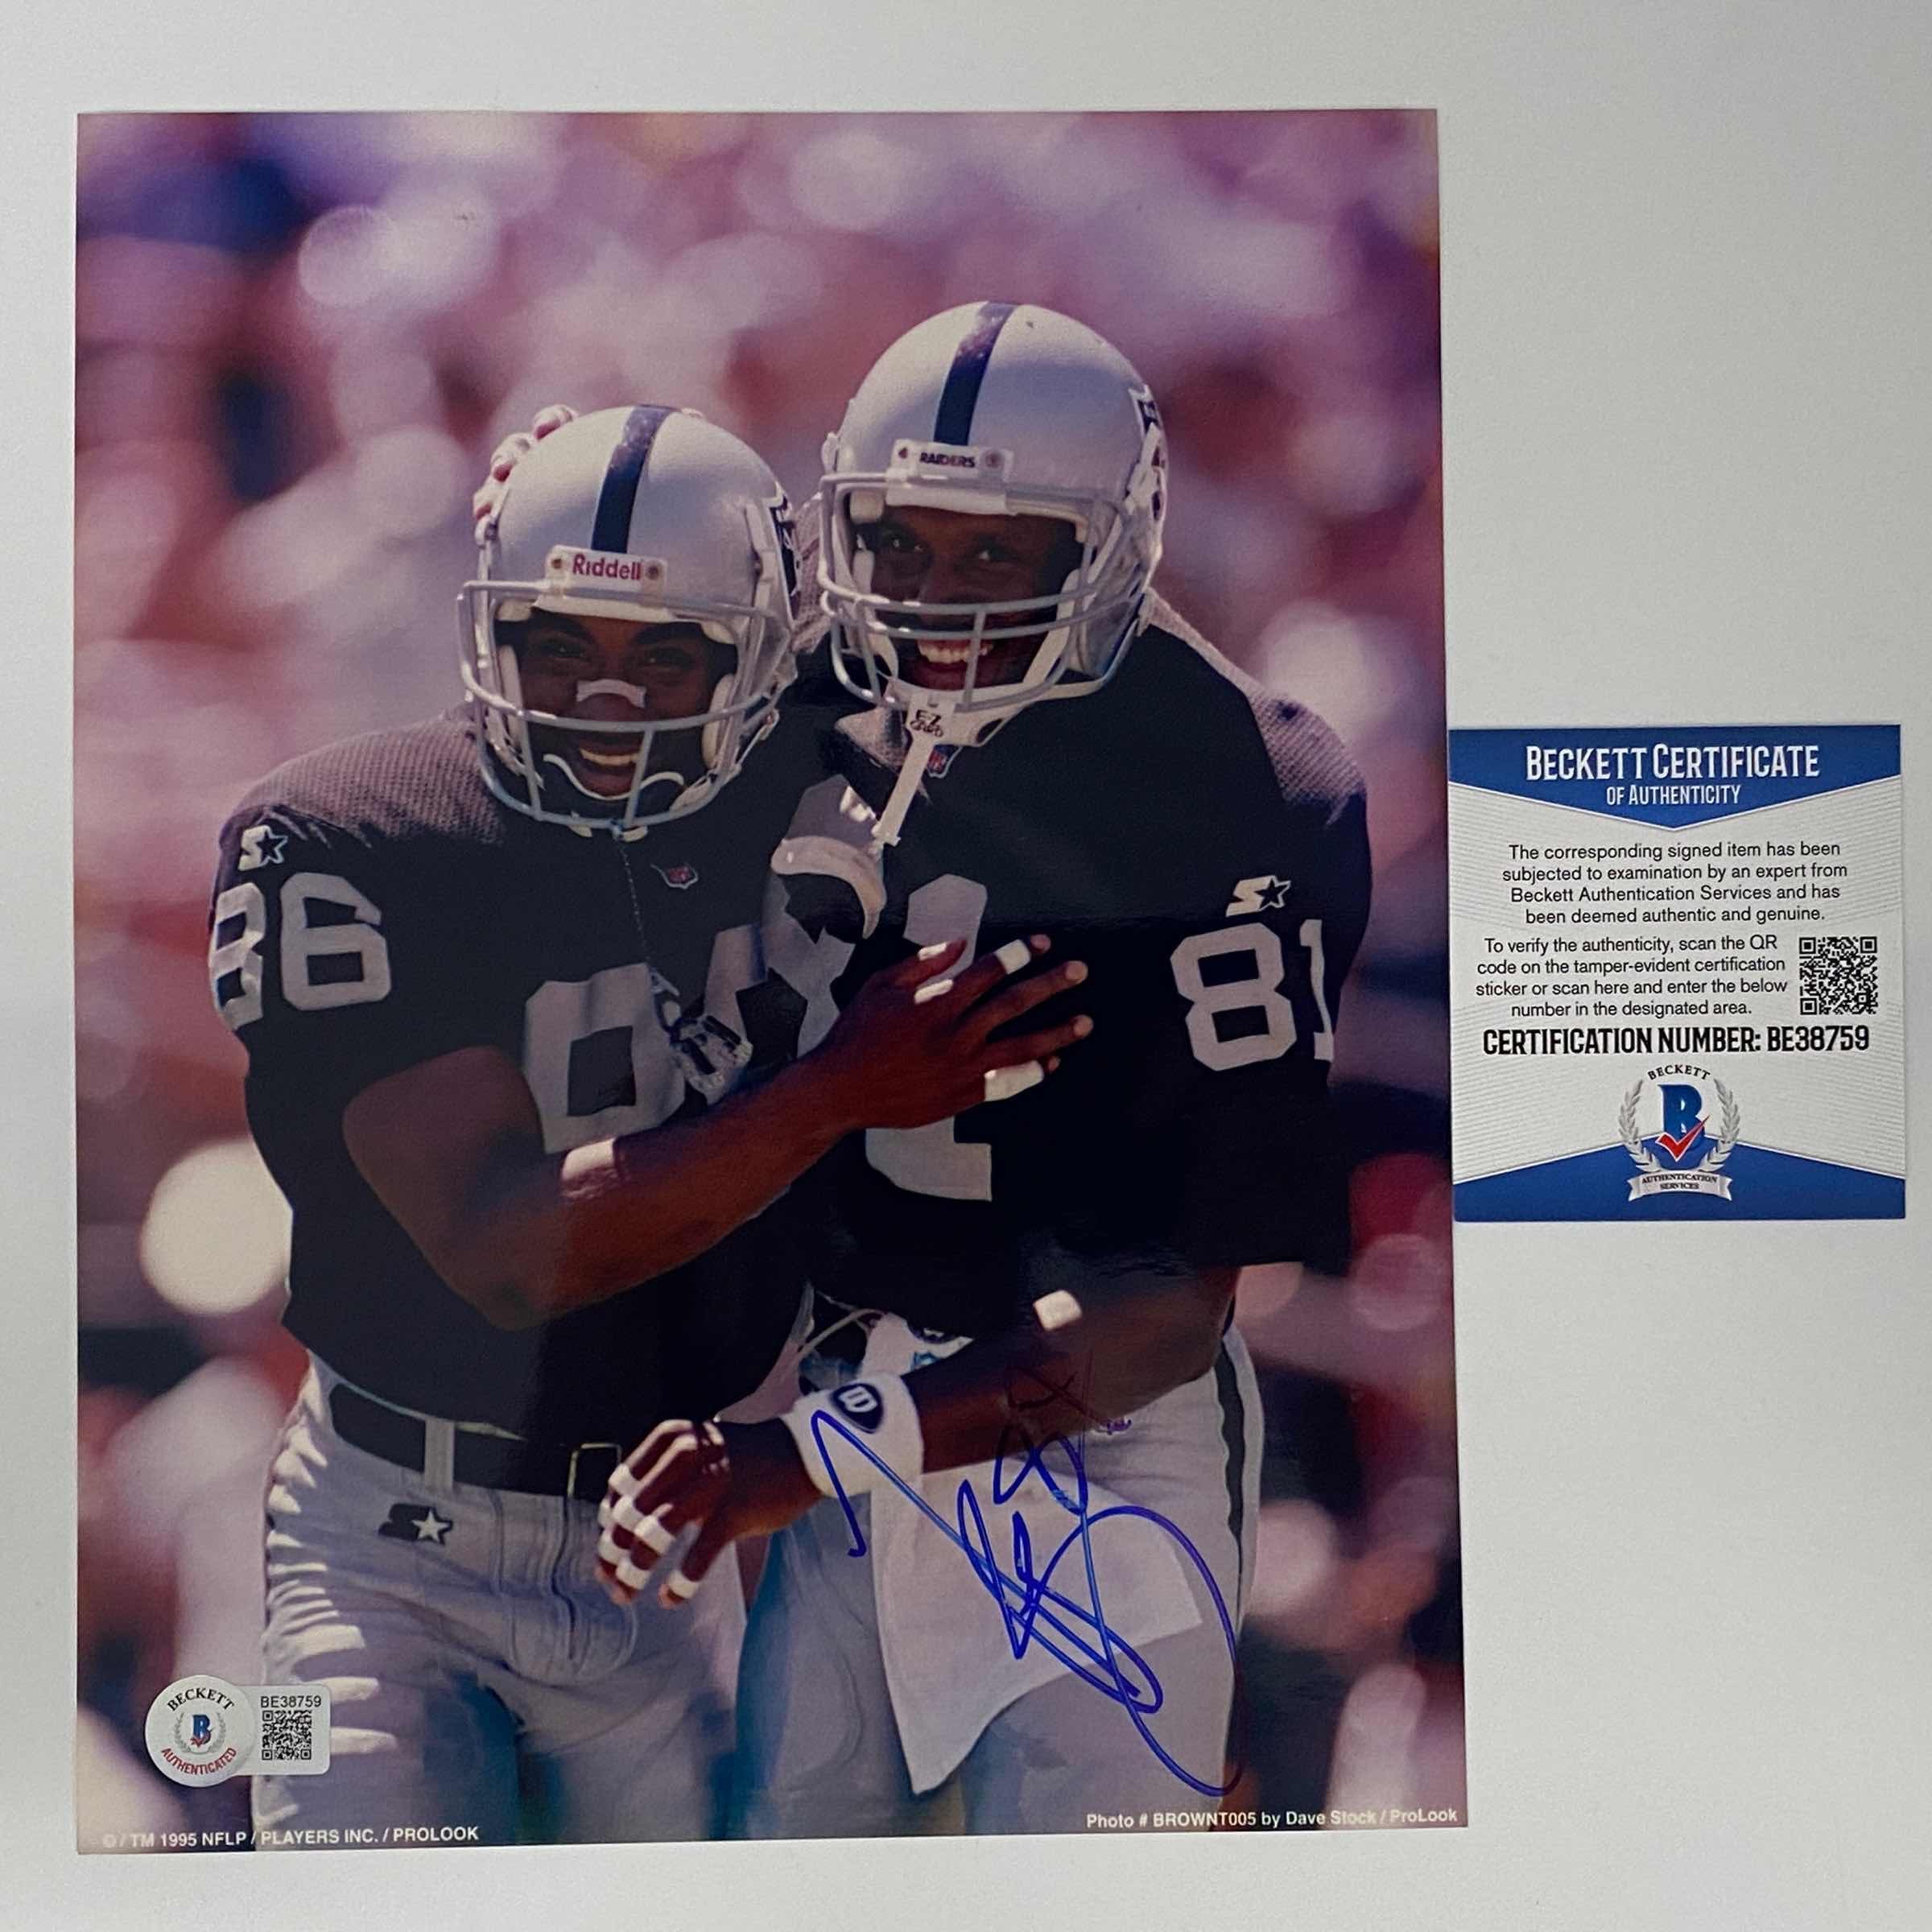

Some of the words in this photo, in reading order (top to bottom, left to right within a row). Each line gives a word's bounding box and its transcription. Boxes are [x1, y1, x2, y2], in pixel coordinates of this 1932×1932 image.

[919, 452, 976, 469] RAIDERS
[572, 553, 642, 580] Riddell
[1526, 745, 1648, 781] BECKETT
[1653, 743, 1820, 778] CERTIFICATE
[1606, 786, 1625, 806] OF
[1629, 784, 1741, 806] AUTHENTICITY
[1508, 844, 1539, 861] The
[1544, 842, 1662, 862] corresponding
[1667, 841, 1723, 861] signed
[1728, 841, 1761, 857] item
[1766, 840, 1795, 857] has
[1800, 840, 1840, 857] been
[1502, 865, 1582, 886] subjected
[1586, 866, 1603, 881] to
[1607, 864, 1703, 881] examination
[1707, 863, 1727, 883] by
[1732, 867, 1751, 878] an
[1756, 864, 1806, 882] expert
[1810, 861, 1847, 878] from
[1511, 886, 1574, 903] Beckett
[1578, 886, 1695, 902] Authentication
[1700, 884, 1772, 901] Services
[1776, 883, 1806, 900] and
[1811, 882, 1841, 899] has
[1525, 908, 1566, 925] been
[1571, 907, 1637, 923] deemed
[1641, 906, 1717, 923] authentic
[1721, 906, 1752, 922] and
[1756, 905, 1825, 925] genuine.
[1484, 938, 1504, 954] To
[1507, 936, 1549, 957] verify
[1553, 936, 1578, 953] the
[1582, 935, 1674, 956] authenticity,
[1678, 939, 1716, 952] scan
[1720, 935, 1745, 952] the
[1749, 934, 1778, 952] QR
[1477, 959, 1517, 975] code
[1521, 962, 1541, 974] on
[1544, 958, 1570, 974] the
[1573, 957, 1690, 977] tamper-evident
[1694, 955, 1785, 972] certification
[1169, 919, 1335, 1071] 81
[1476, 980, 1528, 997] sticker
[1531, 984, 1549, 996] or
[1551, 984, 1590, 996] scan
[1594, 979, 1629, 994] here
[1633, 978, 1663, 994] and
[1666, 980, 1708, 994] enter
[1711, 978, 1736, 993] the
[1740, 976, 1788, 993] below
[1511, 1001, 1571, 1018] number
[1575, 1001, 1589, 1016] in
[1592, 1001, 1617, 1017] the
[1621, 999, 1709, 1019] designated
[1712, 1002, 1752, 1014] area.
[1483, 1027, 1653, 1055] CERTIFICATION
[1657, 1026, 1761, 1054] NUMBER:
[1766, 1024, 1870, 1052] BE38759
[1647, 1063, 1711, 1081] BECKETT
[1641, 1173, 1718, 1184] AUTHENTICATION
[1660, 1181, 1699, 1191] SERVICES
[167, 1686, 235, 1712] BECKETT
[260, 1695, 322, 1708] BE38759
[161, 1746, 237, 1776] AUTHENTICATED
[1086, 1814, 1134, 1828] Photo
[1139, 1813, 1149, 1827] #
[1153, 1811, 1257, 1827] BROWNT005
[1261, 1811, 1282, 1828] by
[1286, 1810, 1326, 1826] Dave
[1330, 1810, 1377, 1825] Stock
[1390, 1808, 1459, 1823] ProLook
[130, 1832, 155, 1847] TM
[160, 1832, 198, 1847] 1995
[201, 1831, 247, 1847] NFLP
[260, 1829, 340, 1845] PLAYERS
[344, 1828, 380, 1843] INC.
[393, 1826, 479, 1842] PROLOOK
